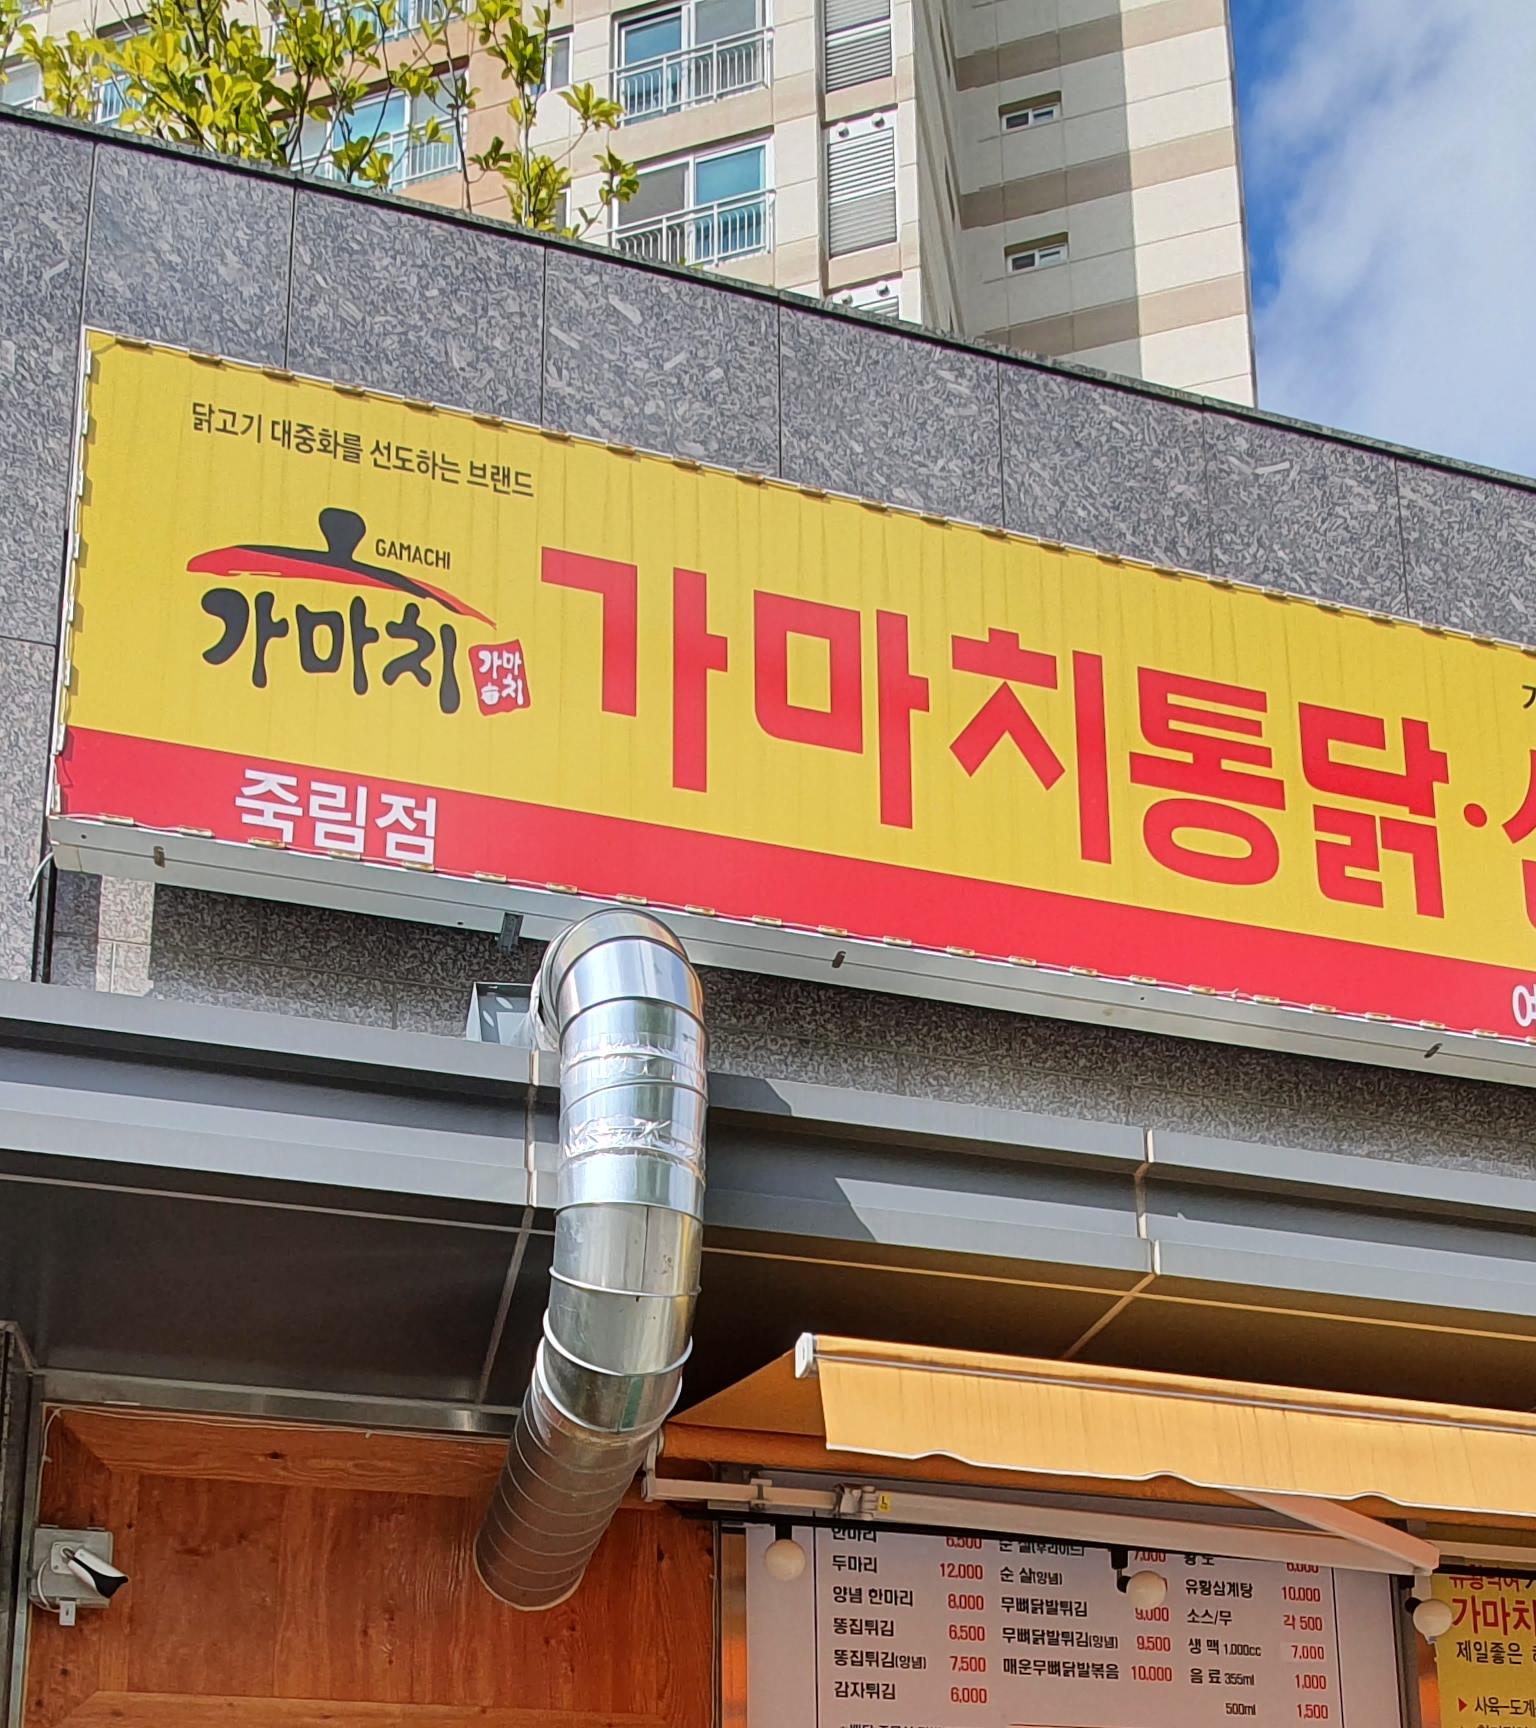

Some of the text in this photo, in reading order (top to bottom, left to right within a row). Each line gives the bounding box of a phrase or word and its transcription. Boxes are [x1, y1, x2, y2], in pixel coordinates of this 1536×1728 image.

[191, 402, 535, 498] 닭고기 대중화를 선도하는 브랜드
[375, 538, 451, 571] GAMACHI
[201, 587, 460, 715] 가마치
[235, 767, 438, 865] 죽림점
[832, 1555, 983, 1580] 두마리 12,000
[833, 1587, 984, 1611] 양념 한마리 8,000
[1185, 1579, 1321, 1602] 유황삼계탕 10,000
[833, 1618, 985, 1641] 똥집튀김 6,500
[1187, 1609, 1322, 1631] 소스/무 각 500
[1136, 1636, 1171, 1652] 9,500
[1188, 1638, 1201, 1654] 생
[1207, 1639, 1219, 1655] 맥
[1291, 1645, 1325, 1660] 7,000
[1456, 1640, 1523, 1665] 제일좋은
[949, 1656, 986, 1672] 7,500
[1131, 1666, 1172, 1682] 10,000
[1190, 1668, 1327, 1690] 음 료 355ml 1,000
[834, 1681, 987, 1703] 감자튀김 6,000
[1225, 1703, 1328, 1719] 500ml 1,500
